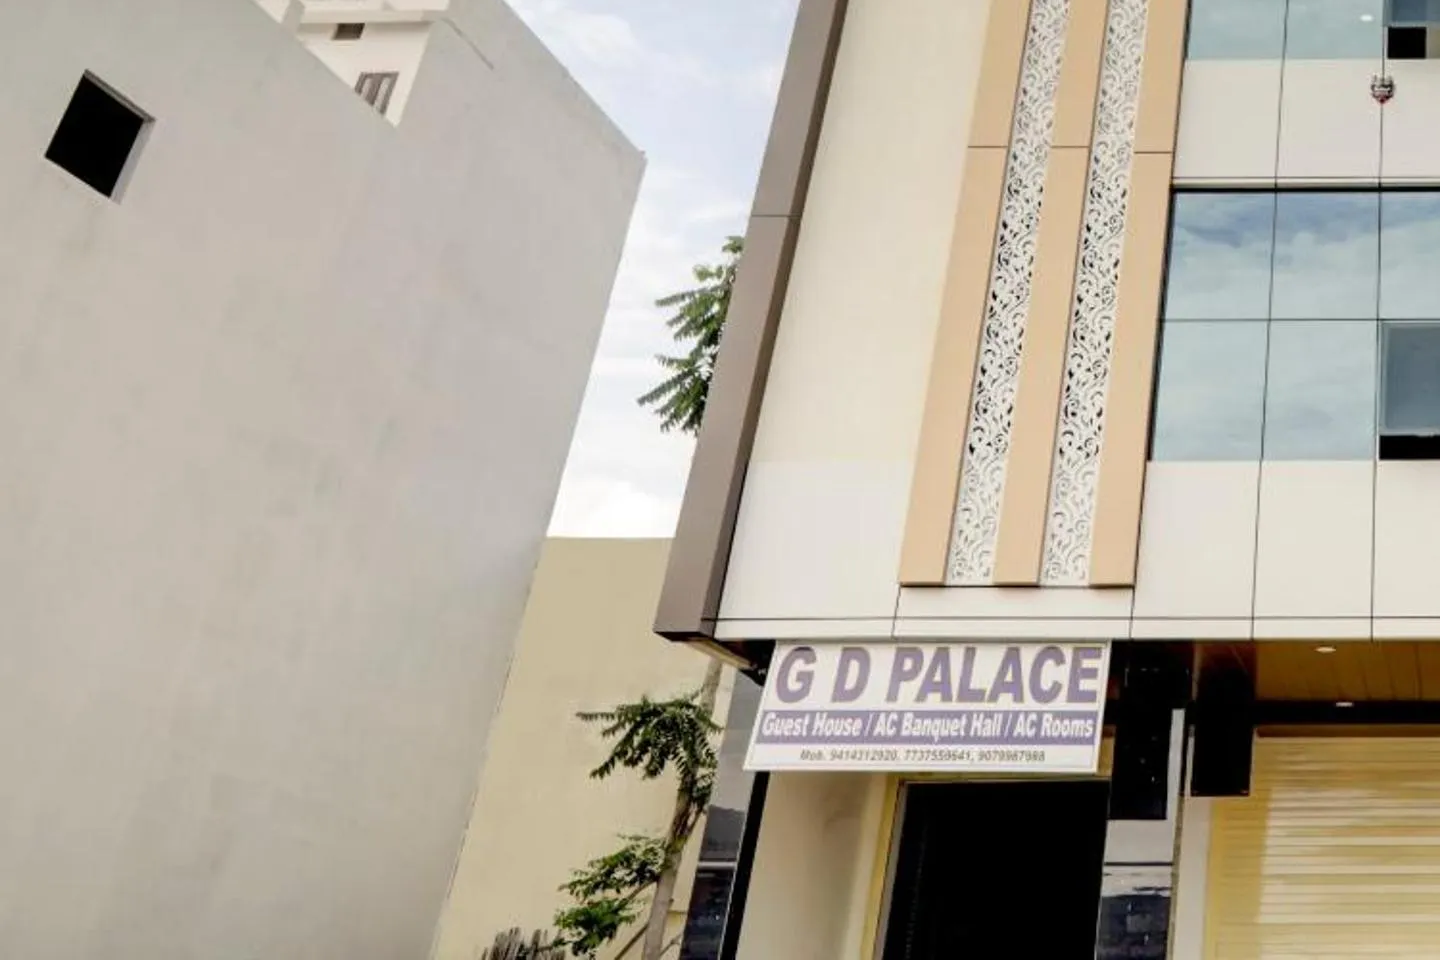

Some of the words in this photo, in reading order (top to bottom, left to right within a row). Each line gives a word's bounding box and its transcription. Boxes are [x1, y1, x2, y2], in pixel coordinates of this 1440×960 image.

[775, 646, 817, 703] G
[831, 646, 871, 702] D
[886, 646, 1101, 703] PALACE
[761, 711, 810, 737] Guest
[811, 712, 863, 737] House
[873, 711, 899, 737] AC
[900, 711, 967, 743] Banquet
[969, 712, 1004, 737] Hall
[1012, 712, 1039, 737] AC
[1040, 712, 1095, 738] Rooms
